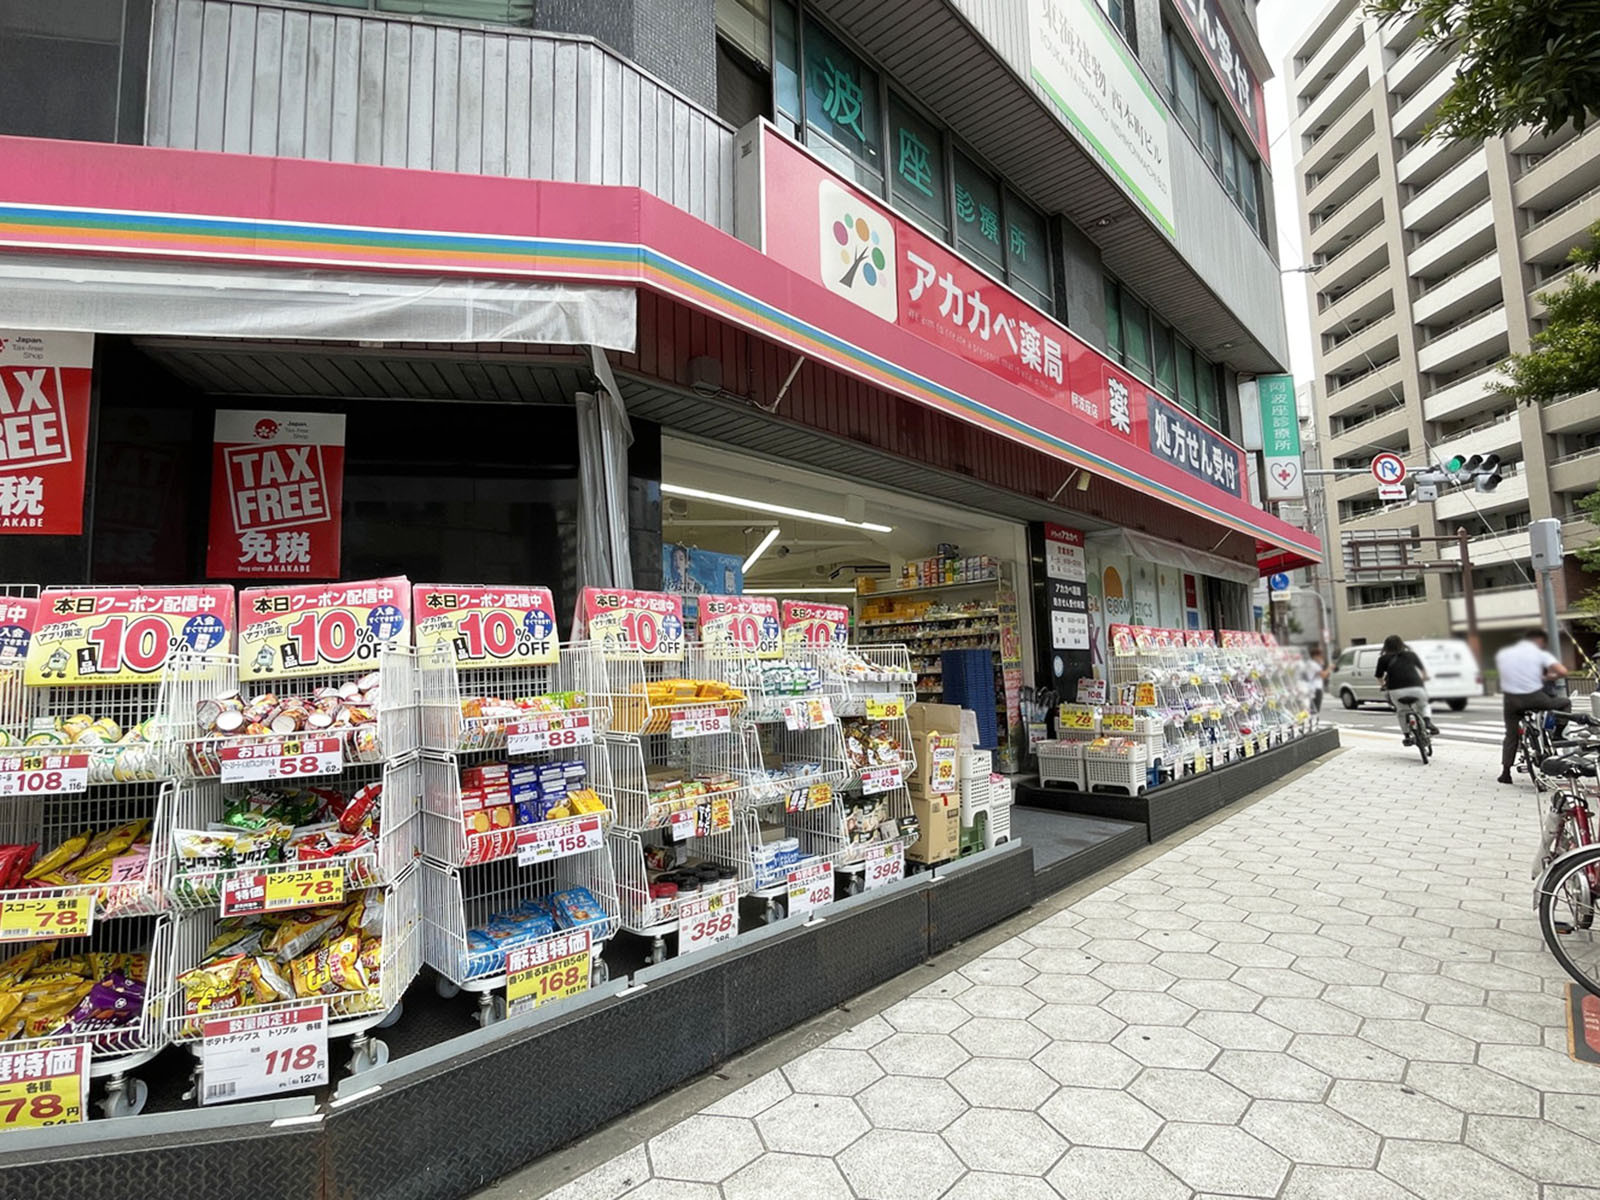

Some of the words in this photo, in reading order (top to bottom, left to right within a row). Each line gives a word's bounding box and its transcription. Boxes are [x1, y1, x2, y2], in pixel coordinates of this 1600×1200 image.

[907, 251, 1063, 384] アカカベ薬局
[1108, 378, 1130, 435] 薬
[1269, 382, 1292, 451] 阿波座診療所
[0, 412, 62, 461] EE
[1154, 407, 1236, 490] 処方せん受付
[232, 447, 316, 488] TAX
[236, 481, 324, 525] FREE
[238, 531, 312, 564] 免税
[267, 565, 311, 573] AKAKABE
[517, 641, 550, 656] OFF
[659, 641, 681, 654] OFF
[760, 640, 778, 652] OFF
[269, 873, 313, 885] ドンタコス
[5, 902, 47, 913] スコーン
[509, 932, 587, 973] 厳選特価
[230, 1011, 299, 1033] 数量限定!!
[268, 1026, 299, 1038] トリプル
